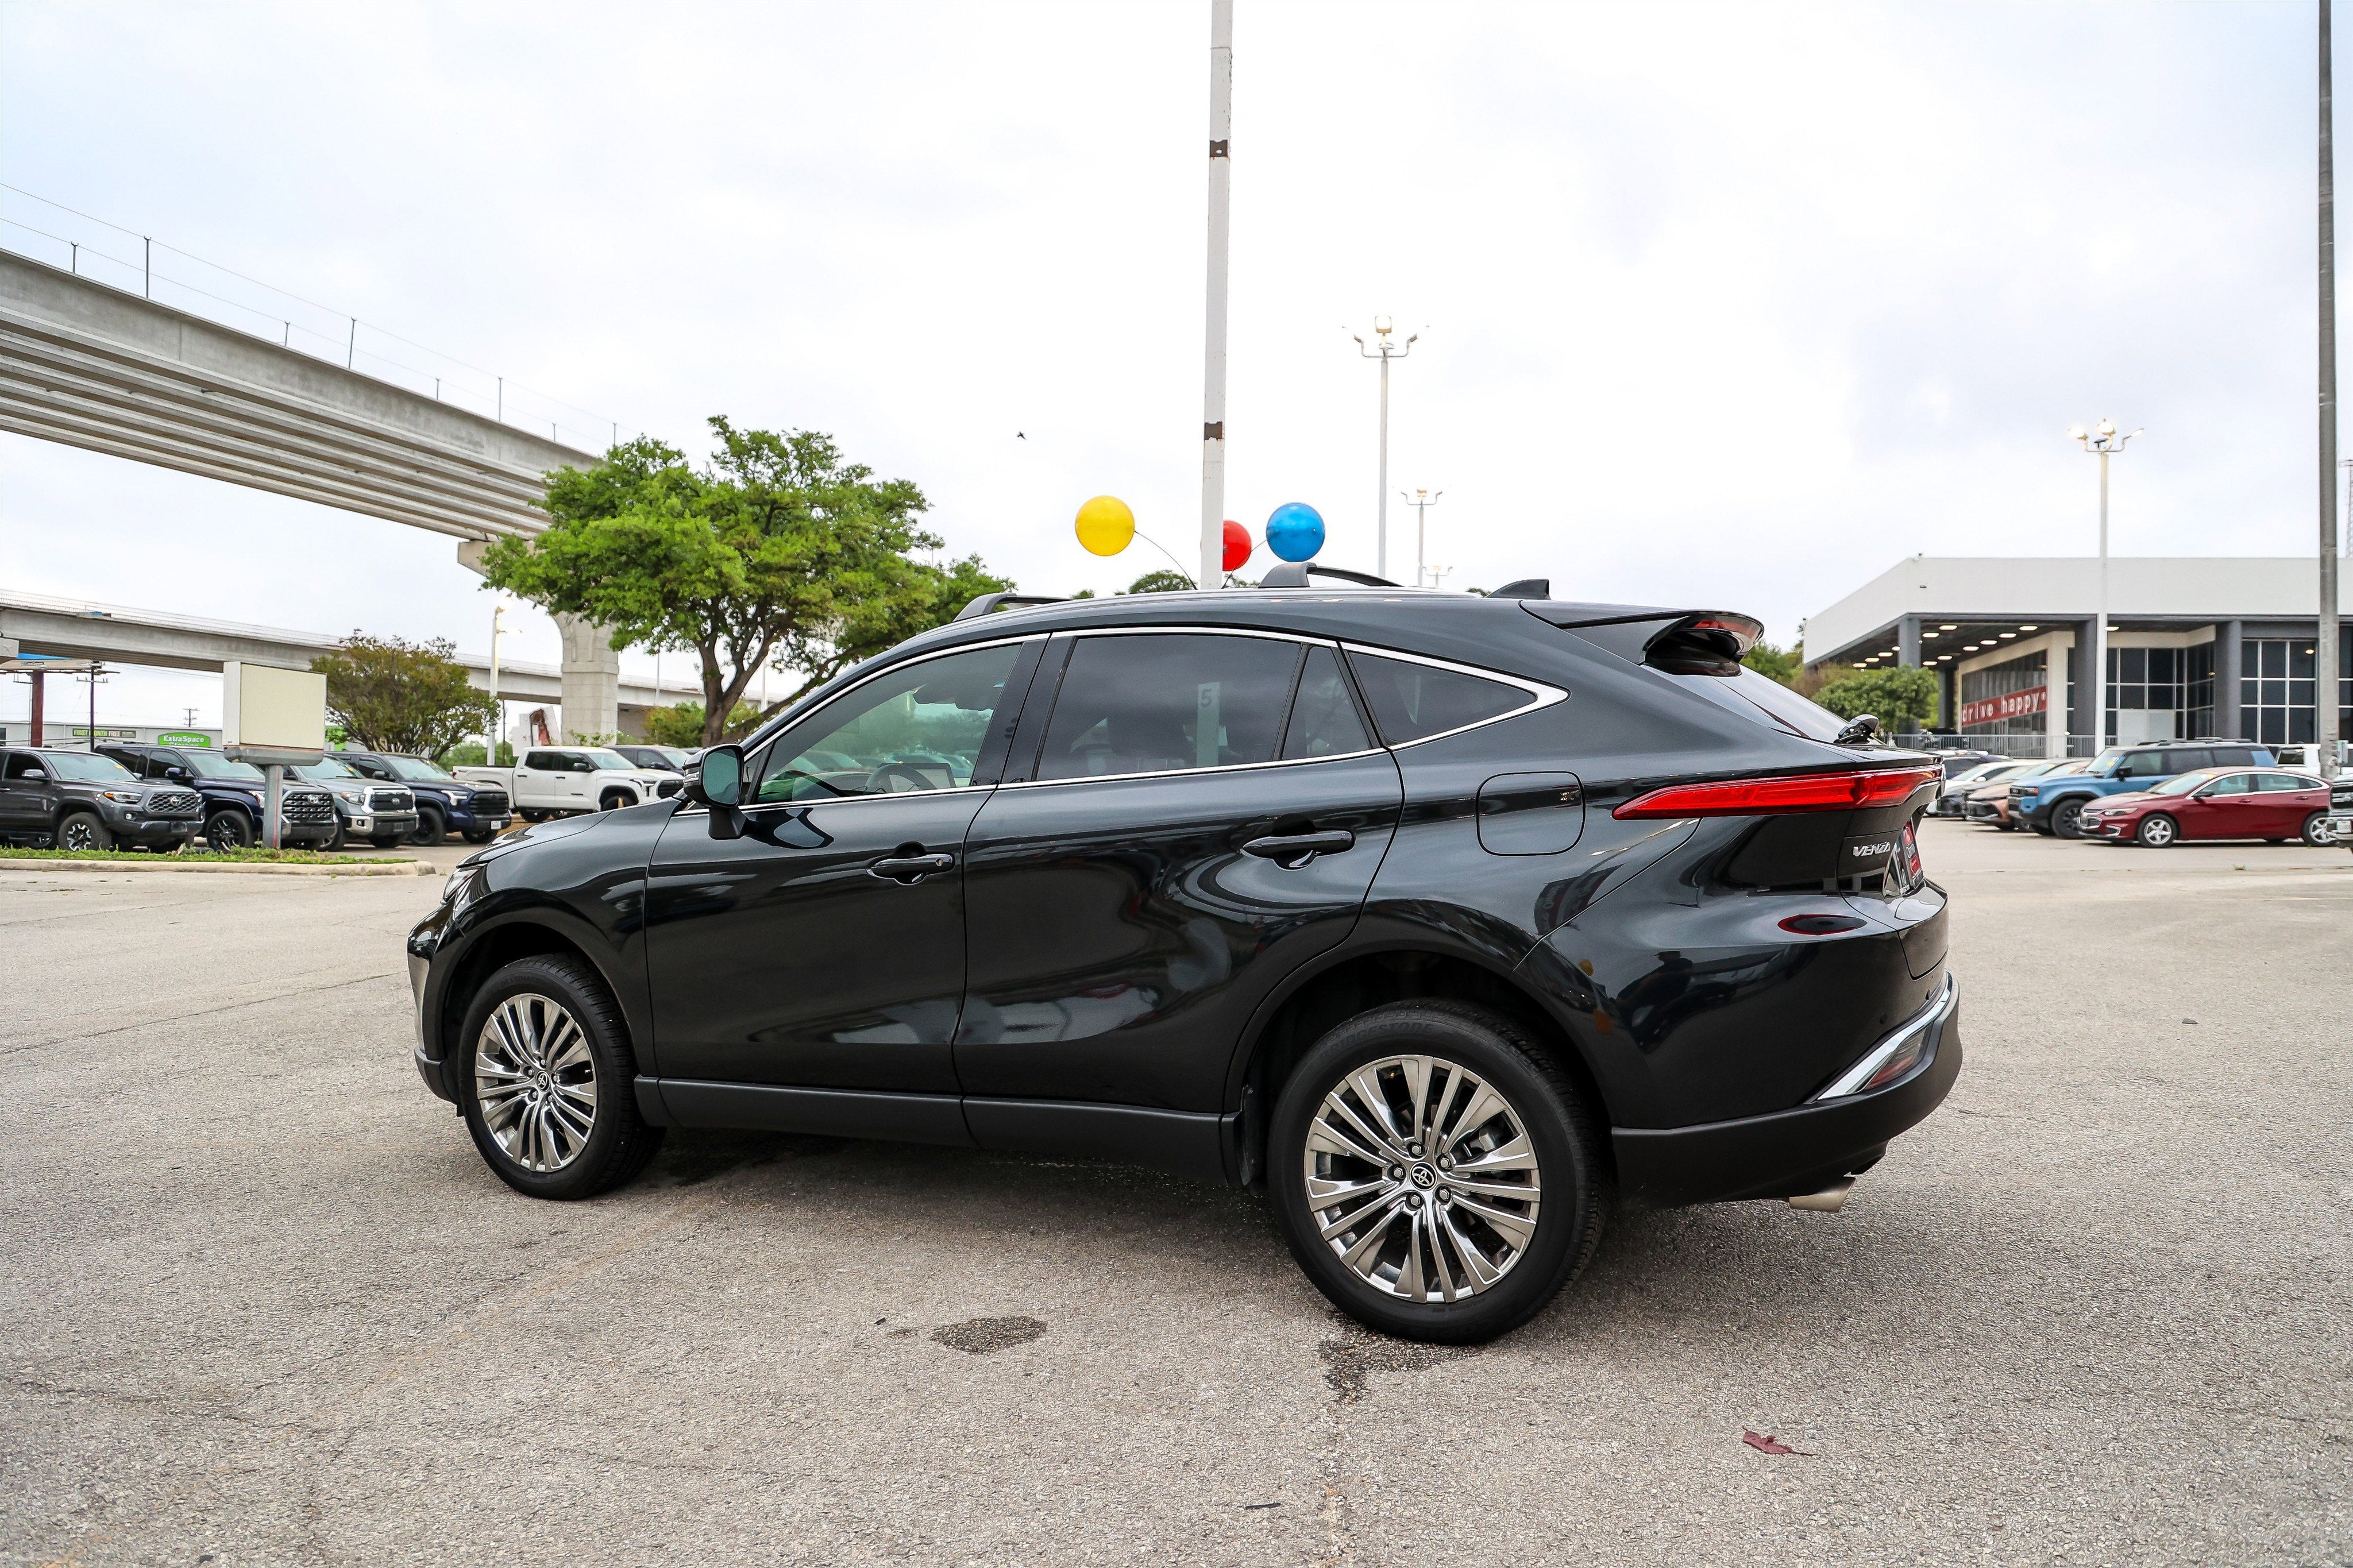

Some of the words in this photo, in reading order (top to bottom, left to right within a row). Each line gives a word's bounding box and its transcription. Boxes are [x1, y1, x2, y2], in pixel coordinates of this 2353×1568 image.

[1200, 687, 1213, 708] 5
[1962, 702, 1994, 722] drive
[2000, 692, 2039, 716] happy
